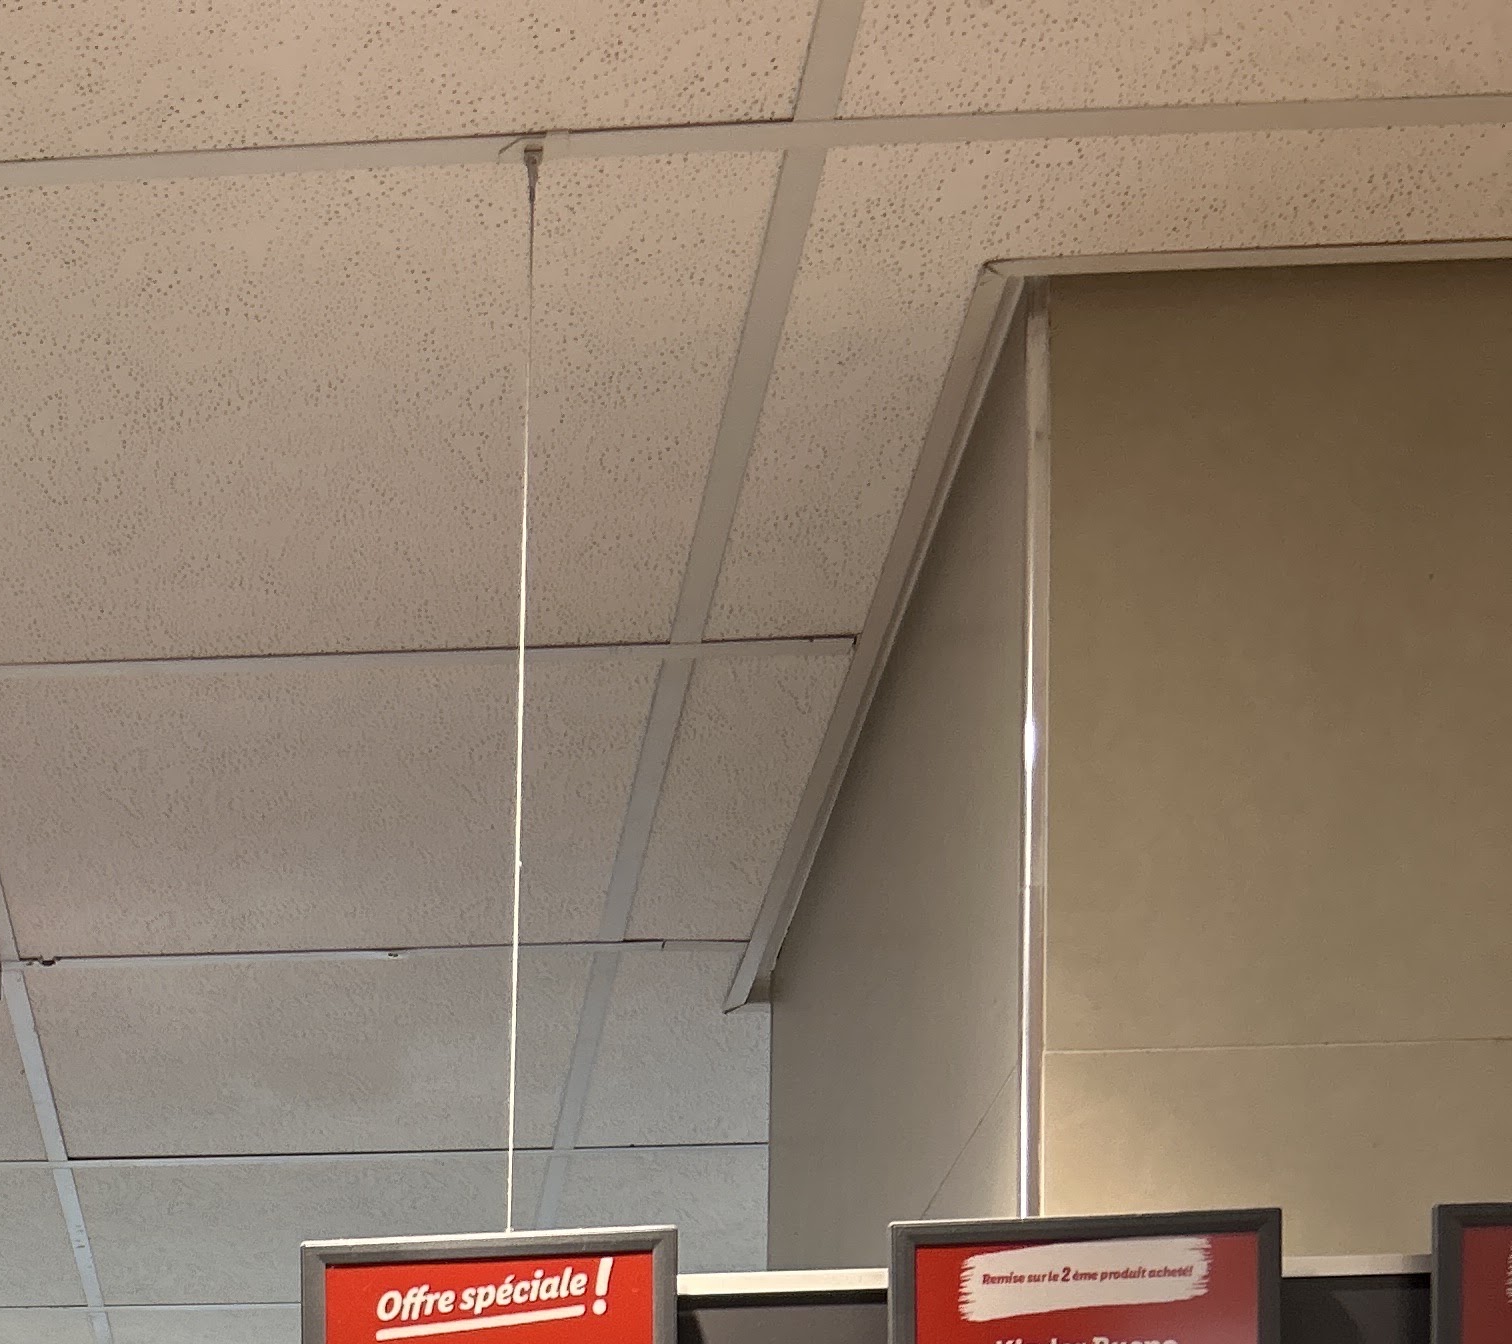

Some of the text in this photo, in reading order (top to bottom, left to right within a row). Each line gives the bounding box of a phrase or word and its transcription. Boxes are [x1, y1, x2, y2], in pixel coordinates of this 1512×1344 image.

[377, 1283, 454, 1322] Offre
[459, 1266, 587, 1315] spéciale
[983, 1272, 1025, 1285] Remise
[1027, 1273, 1046, 1283] sur
[1048, 1271, 1059, 1282] le
[1062, 1267, 1071, 1281] 2
[1100, 1267, 1146, 1282] produit
